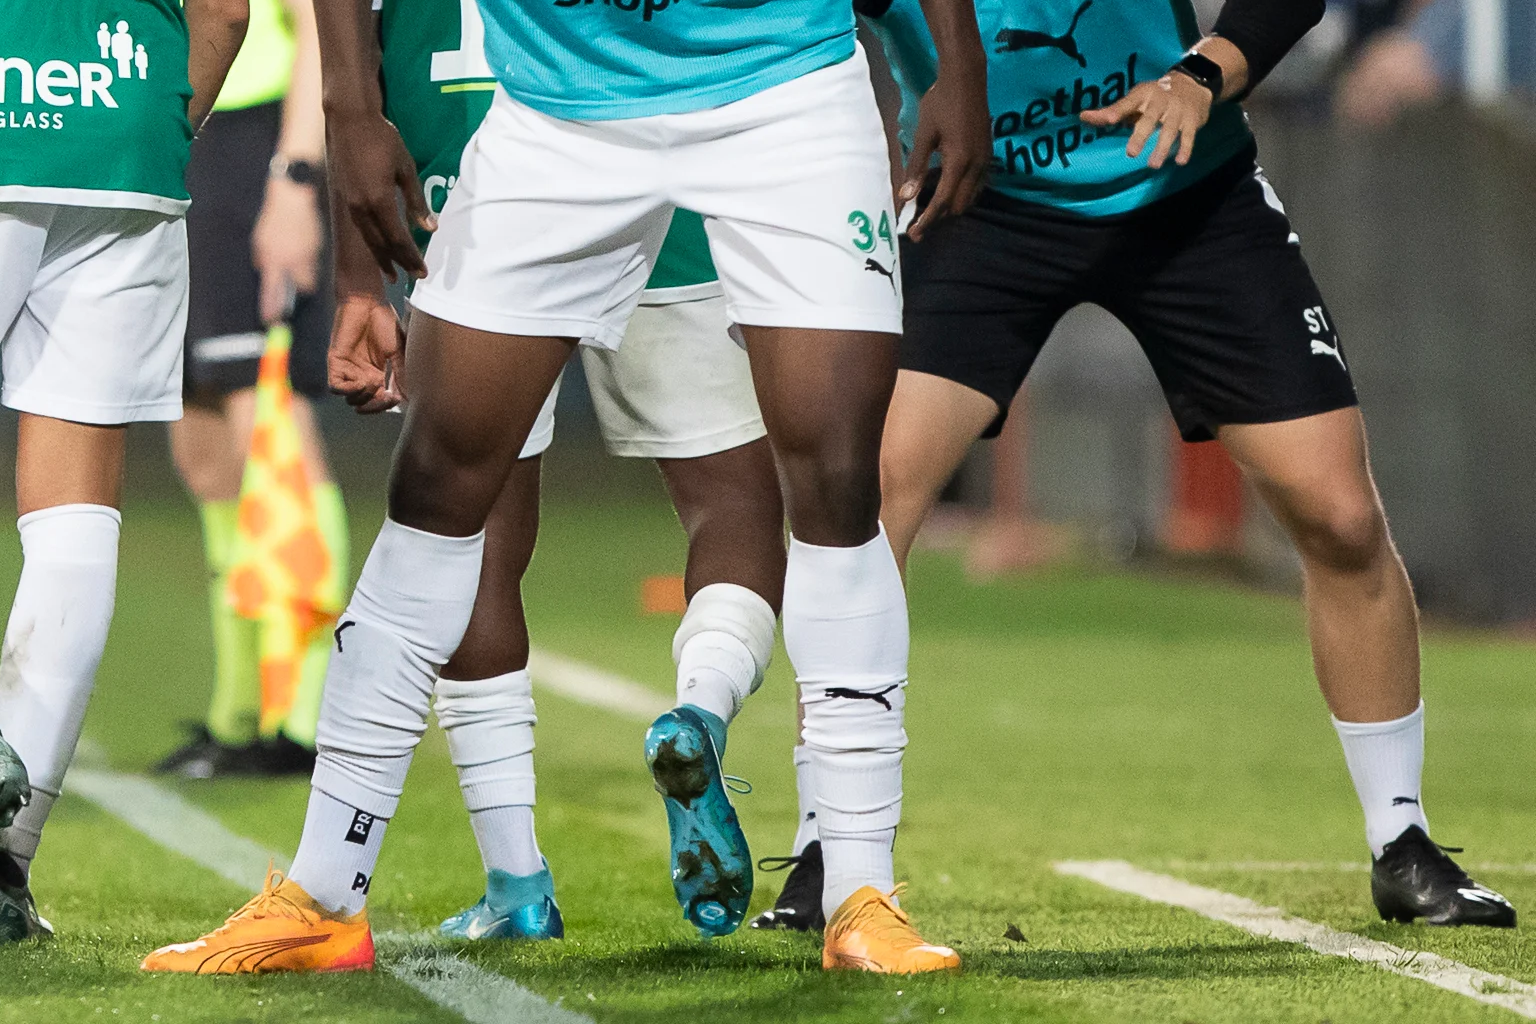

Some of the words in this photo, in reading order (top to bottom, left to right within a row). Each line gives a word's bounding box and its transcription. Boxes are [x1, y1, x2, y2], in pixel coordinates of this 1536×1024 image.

[993, 52, 1138, 138] oetbal
[847, 209, 895, 254] 34
[1303, 305, 1330, 334] ST
